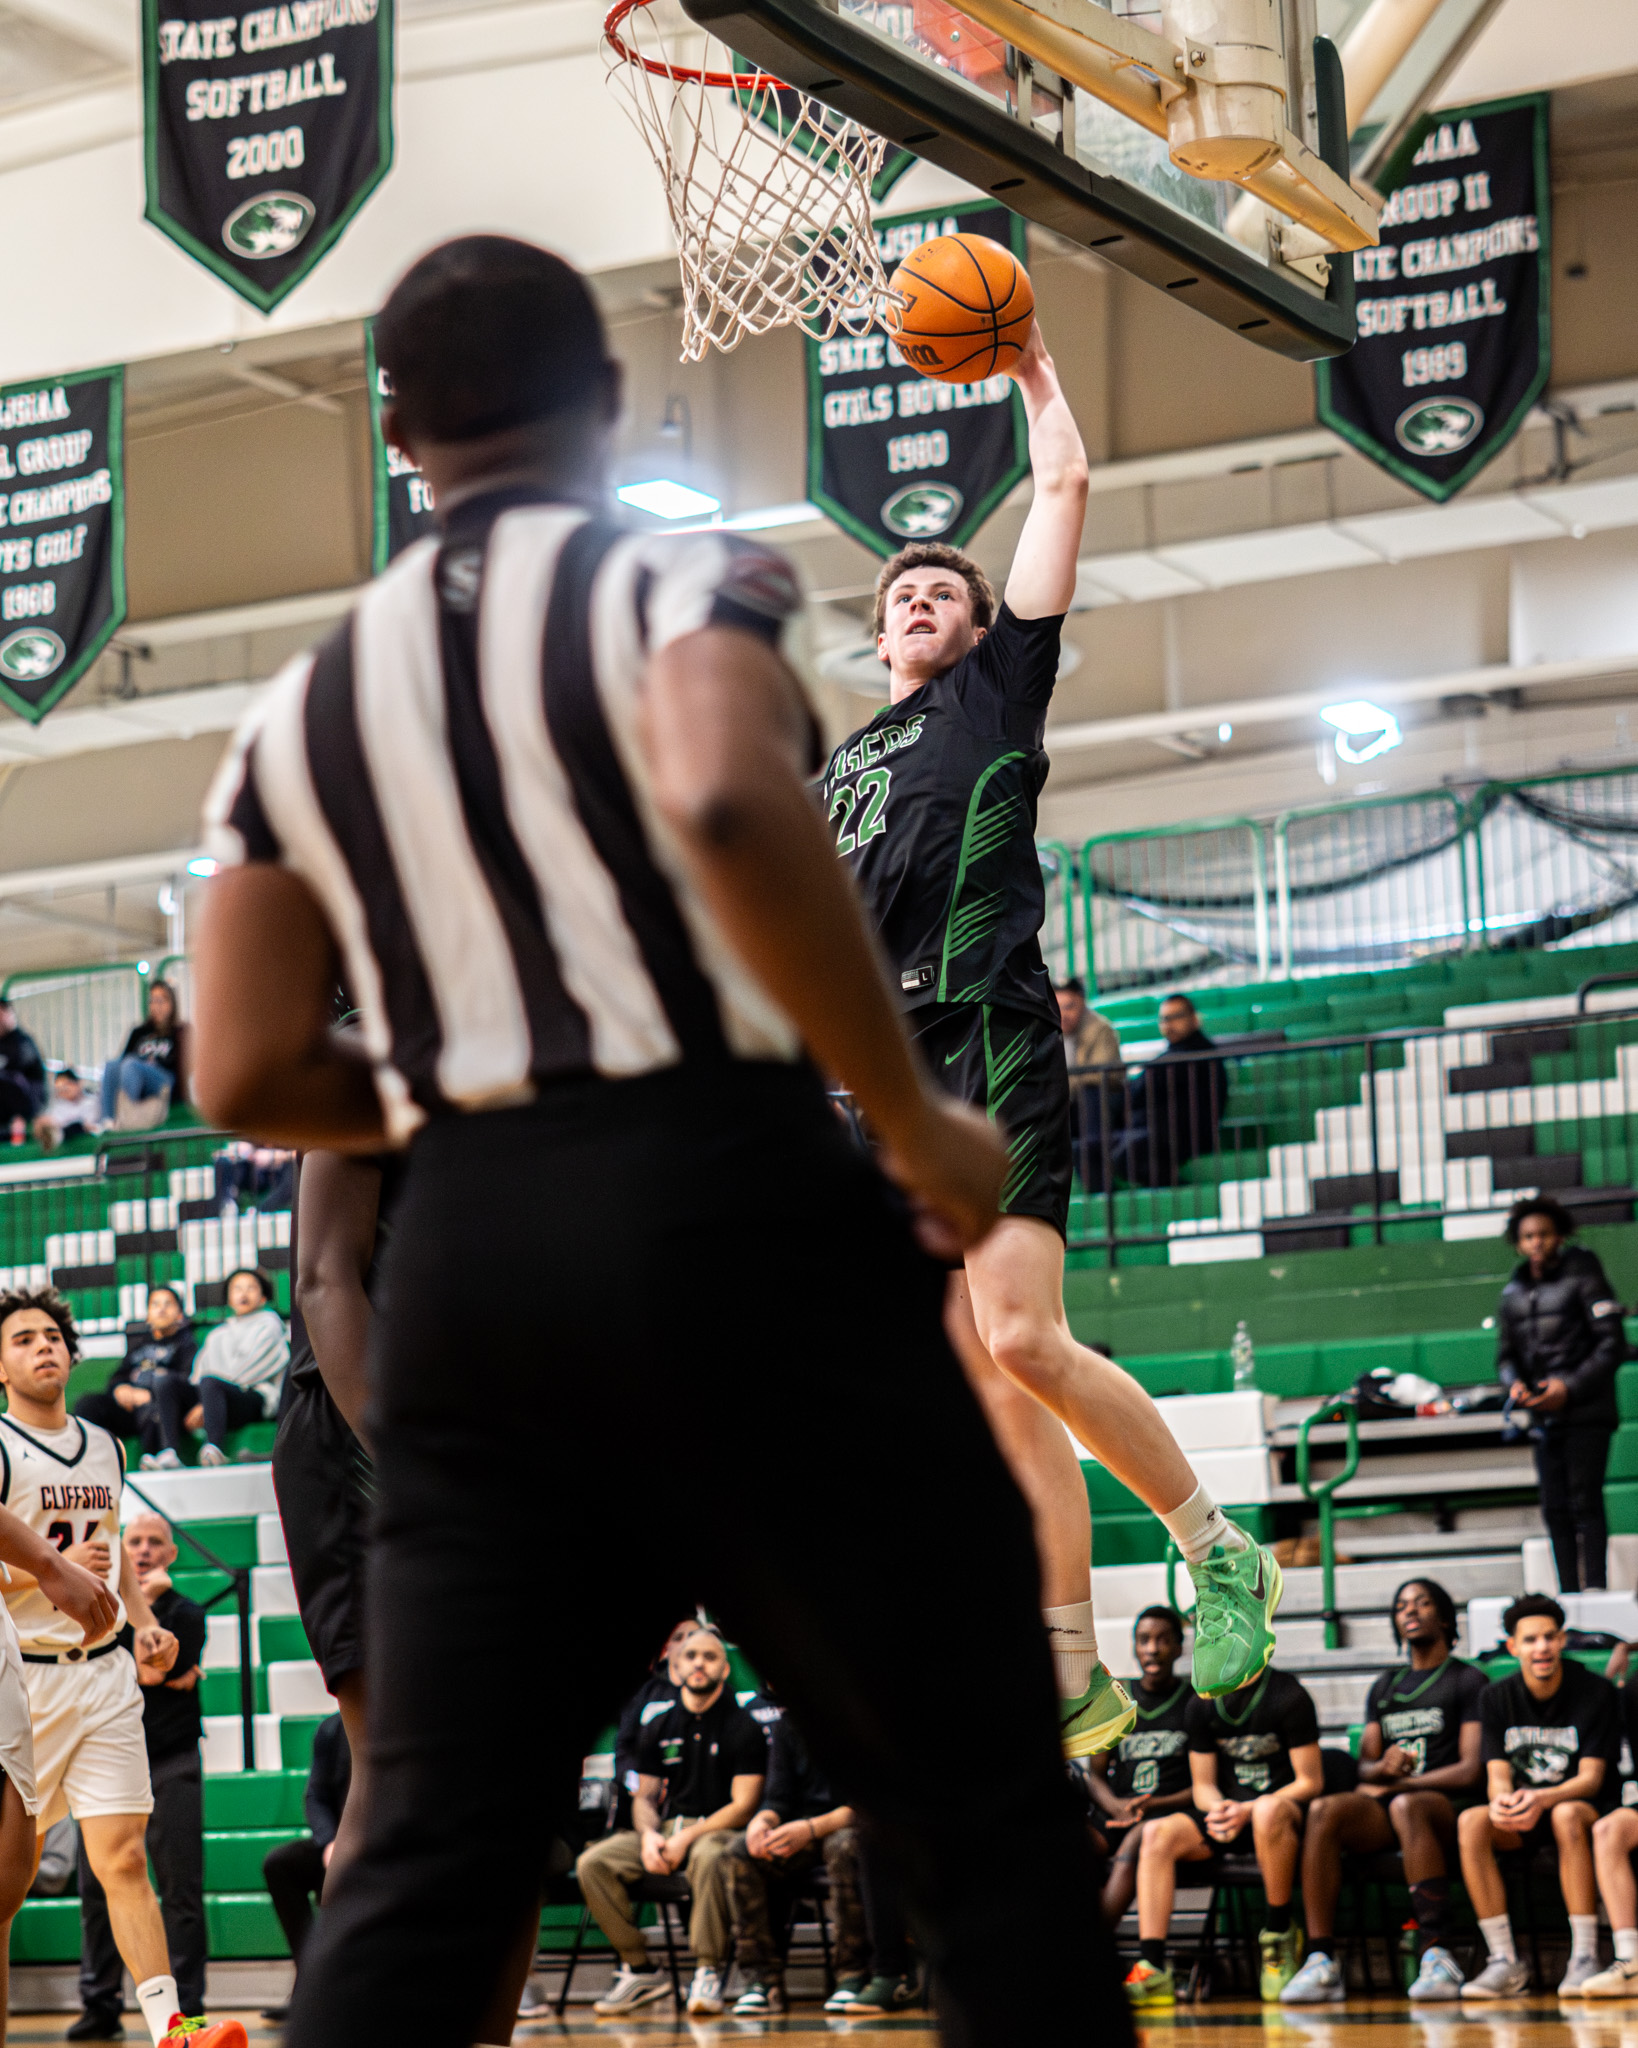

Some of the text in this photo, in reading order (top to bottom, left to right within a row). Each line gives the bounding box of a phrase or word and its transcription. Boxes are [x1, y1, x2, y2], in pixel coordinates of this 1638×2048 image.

[185, 52, 347, 121] SOFTBALL
[226, 125, 305, 180] 2000
[1356, 277, 1507, 338] SOFTBALL
[829, 766, 892, 859] 22
[40, 1485, 114, 1511] CLIFFSIDE
